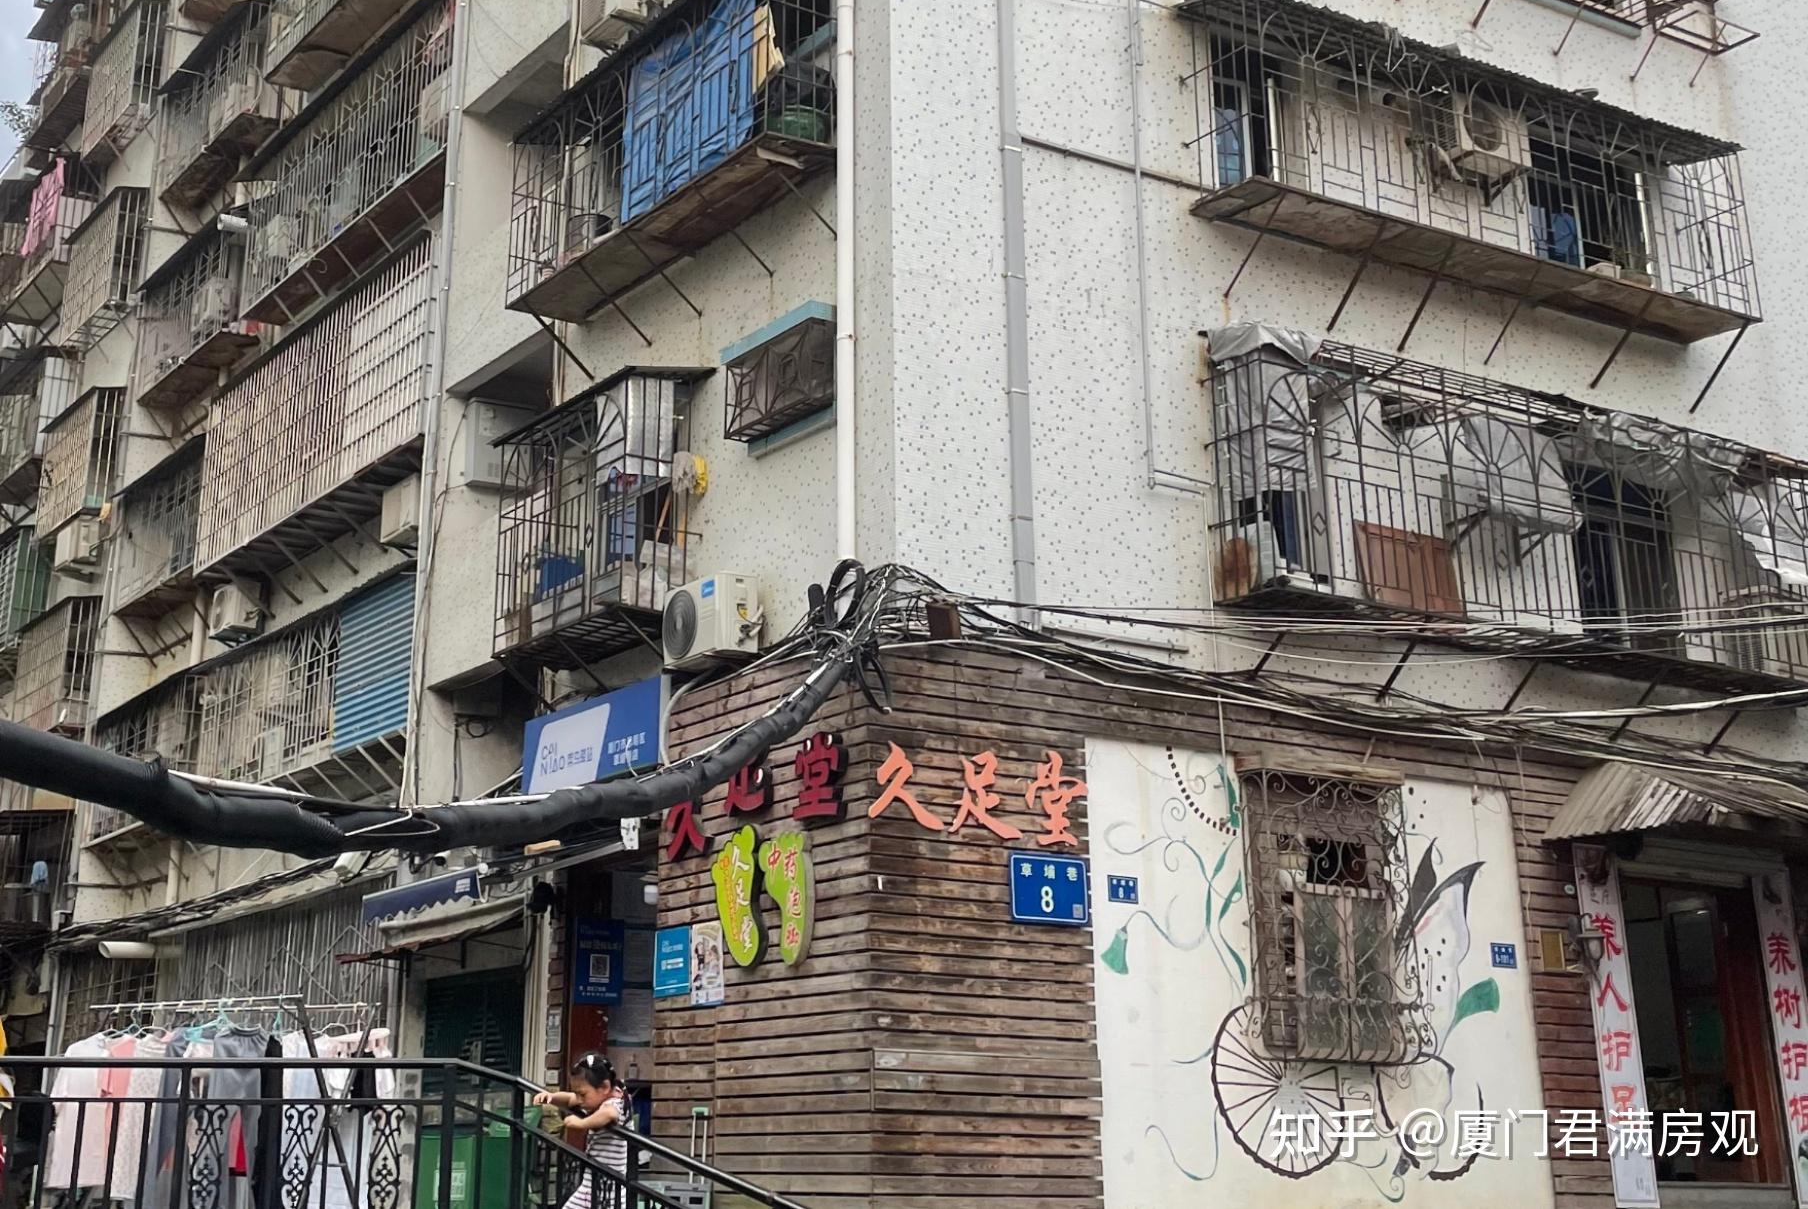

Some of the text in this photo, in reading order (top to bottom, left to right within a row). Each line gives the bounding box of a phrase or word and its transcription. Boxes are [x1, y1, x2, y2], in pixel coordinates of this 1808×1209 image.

[868, 740, 1089, 846] 久足堂
[1041, 885, 1054, 913] 8
